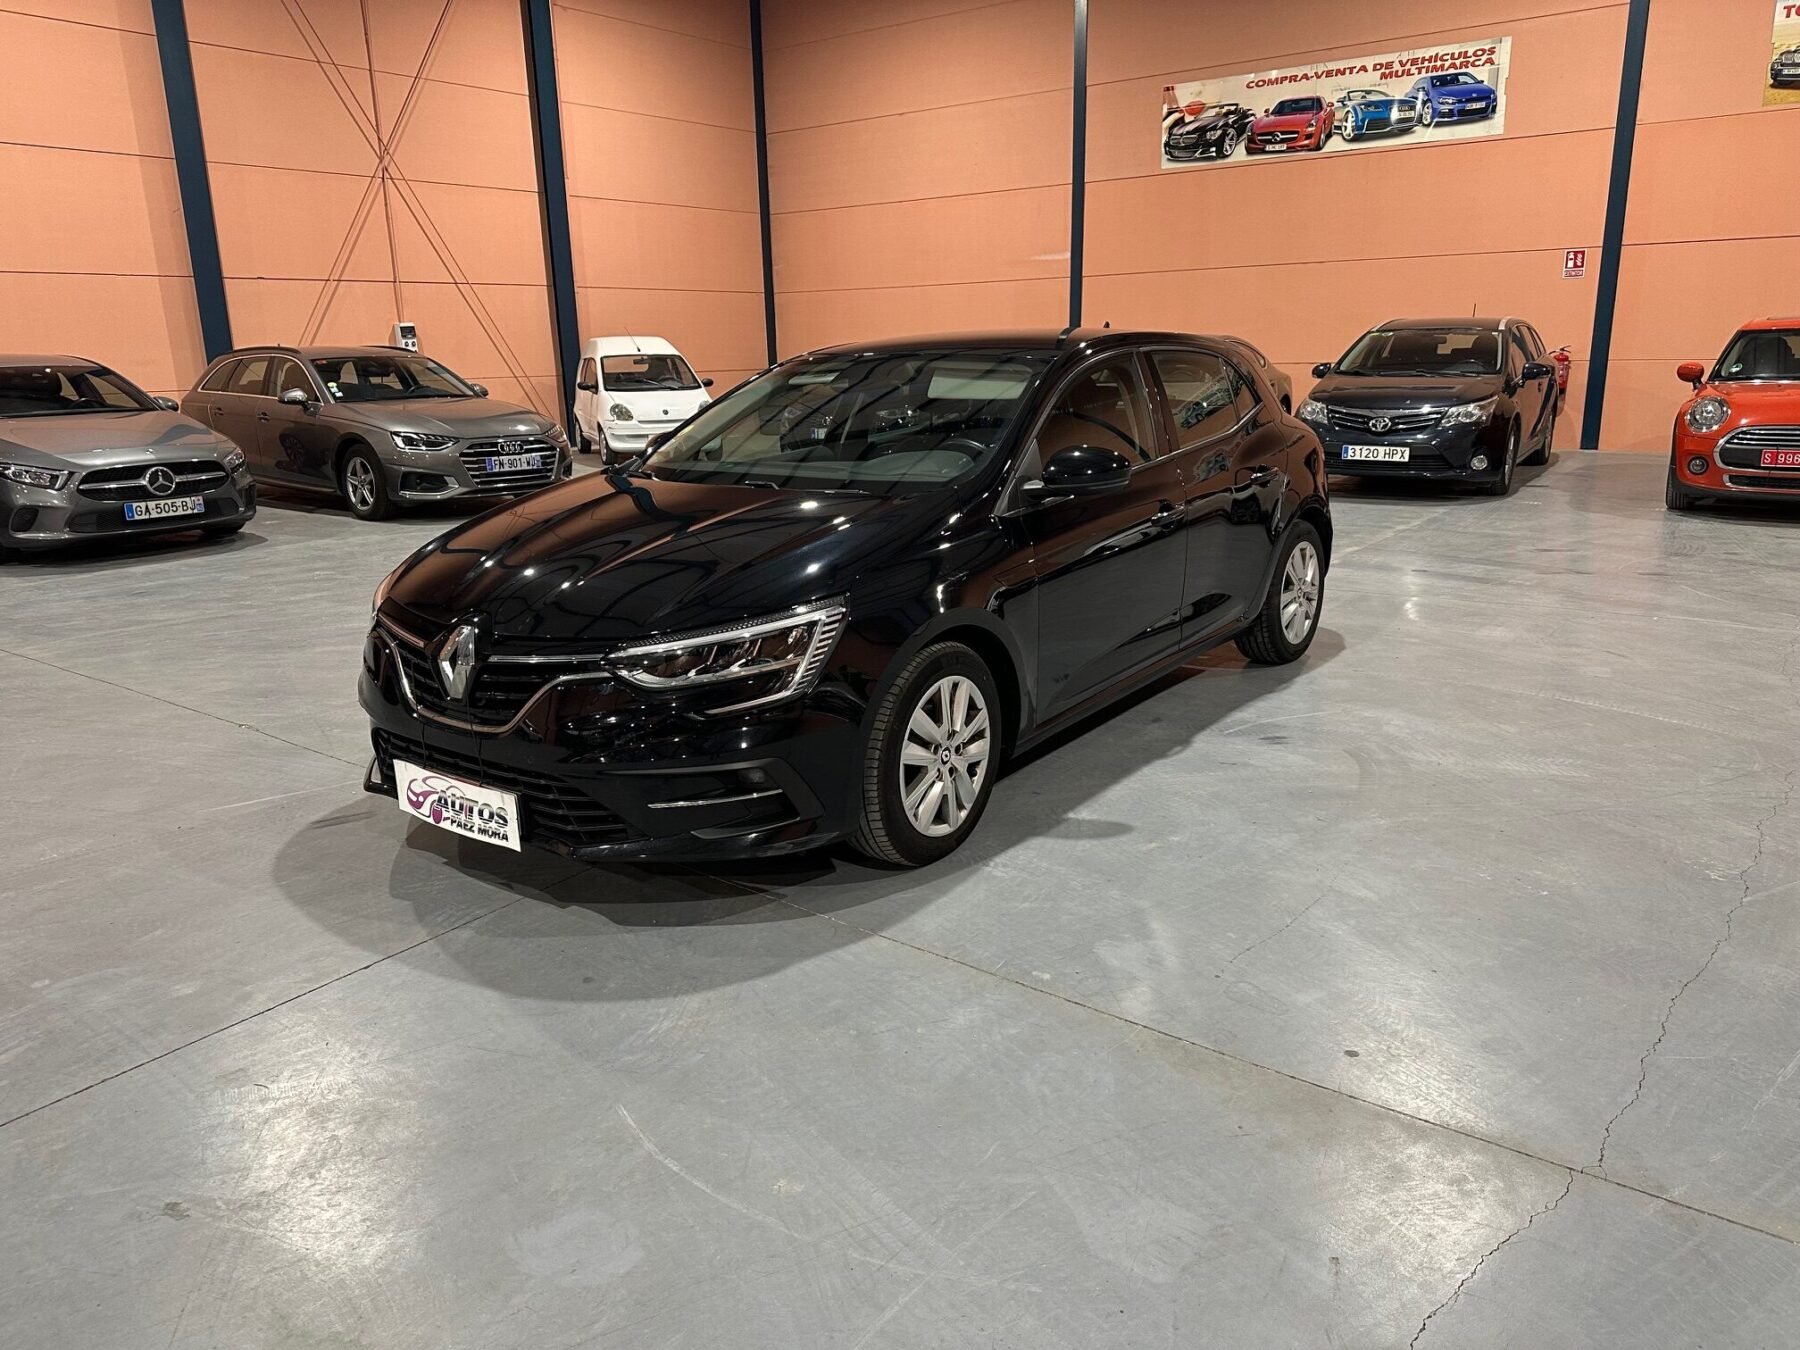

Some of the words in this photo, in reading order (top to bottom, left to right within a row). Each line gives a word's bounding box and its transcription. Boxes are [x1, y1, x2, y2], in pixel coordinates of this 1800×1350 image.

[1246, 65, 1368, 89] COMPRA-VENTA
[1372, 61, 1395, 72] DE
[1398, 46, 1496, 67] VEHÍCULOS
[1380, 57, 1496, 80] MULTIMARCA
[1350, 447, 1379, 459] 3120
[1383, 447, 1407, 460] HPX
[1764, 453, 1772, 464] S
[135, 500, 196, 517] GA-505-BJ
[436, 789, 508, 828] AUTOS
[477, 823, 509, 842] MORA
